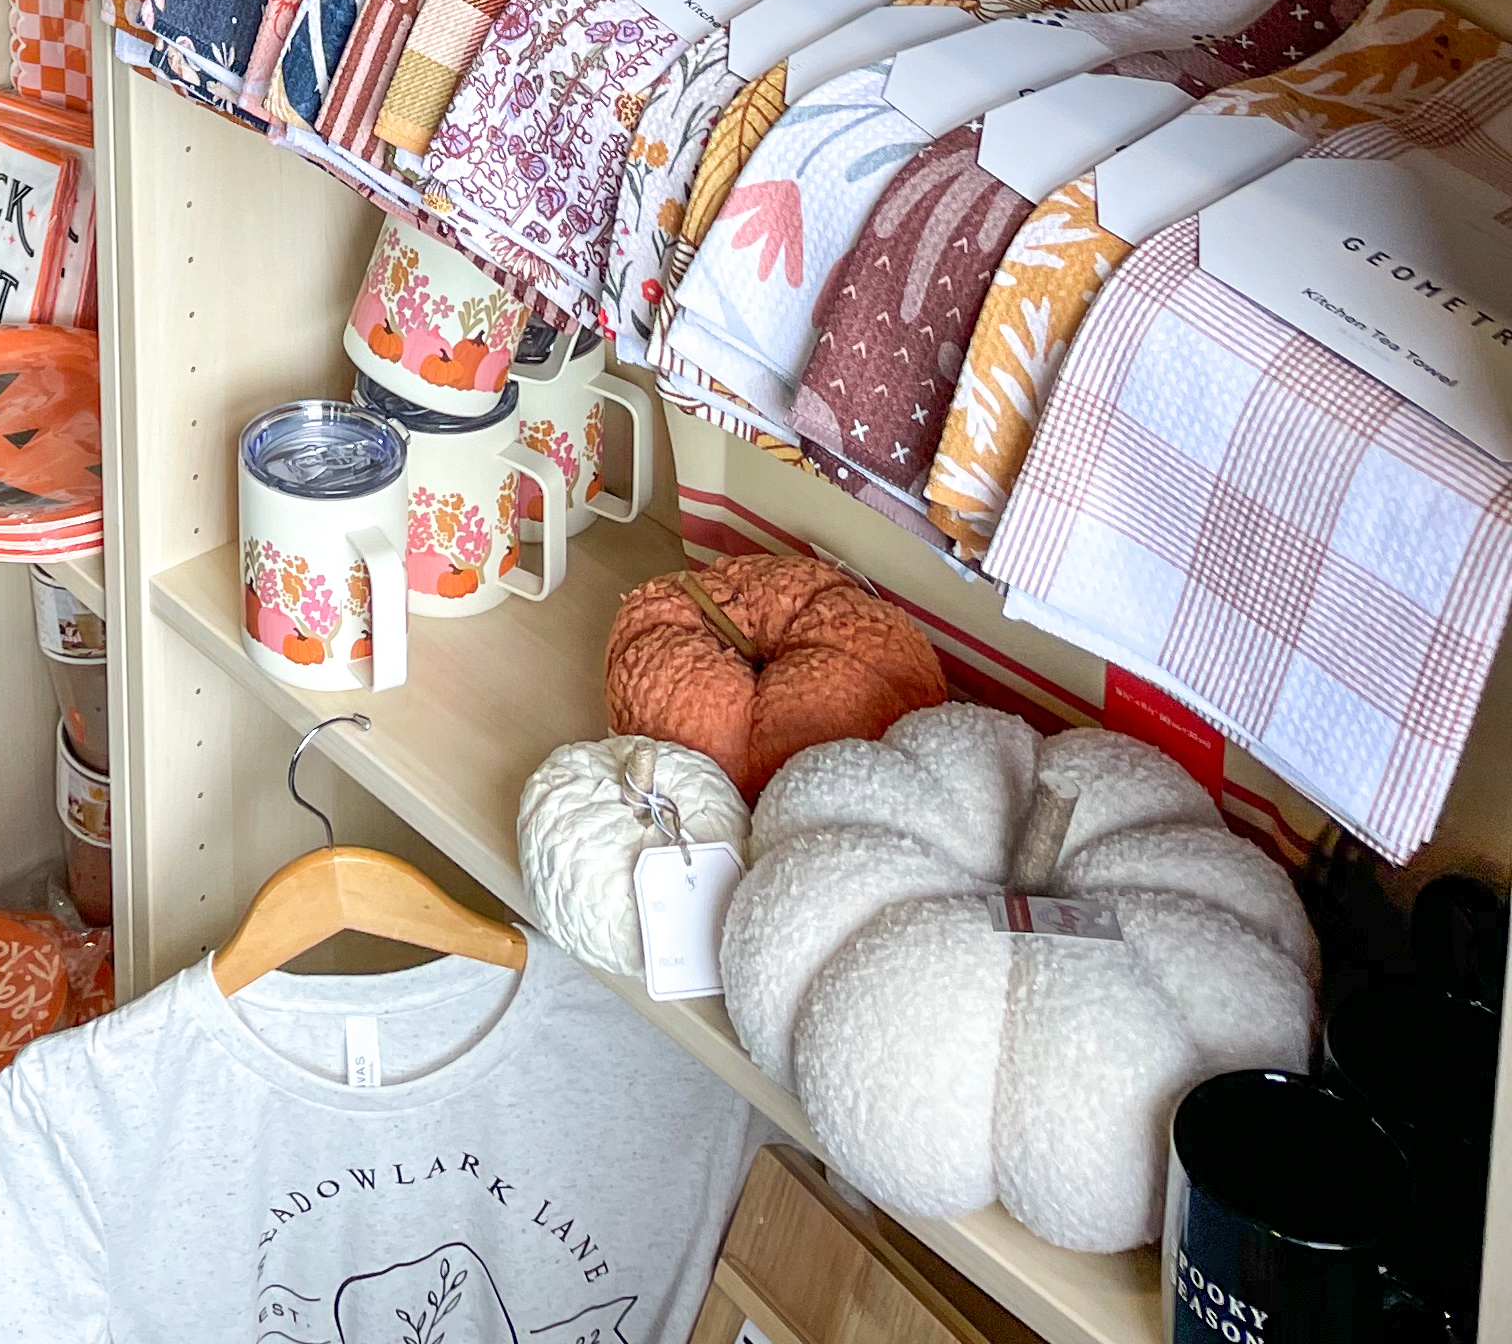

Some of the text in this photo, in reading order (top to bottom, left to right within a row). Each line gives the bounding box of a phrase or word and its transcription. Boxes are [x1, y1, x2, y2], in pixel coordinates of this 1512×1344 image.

[1302, 288, 1459, 387] Kitchen Tea Towel
[531, 1200, 609, 1284] LANE
